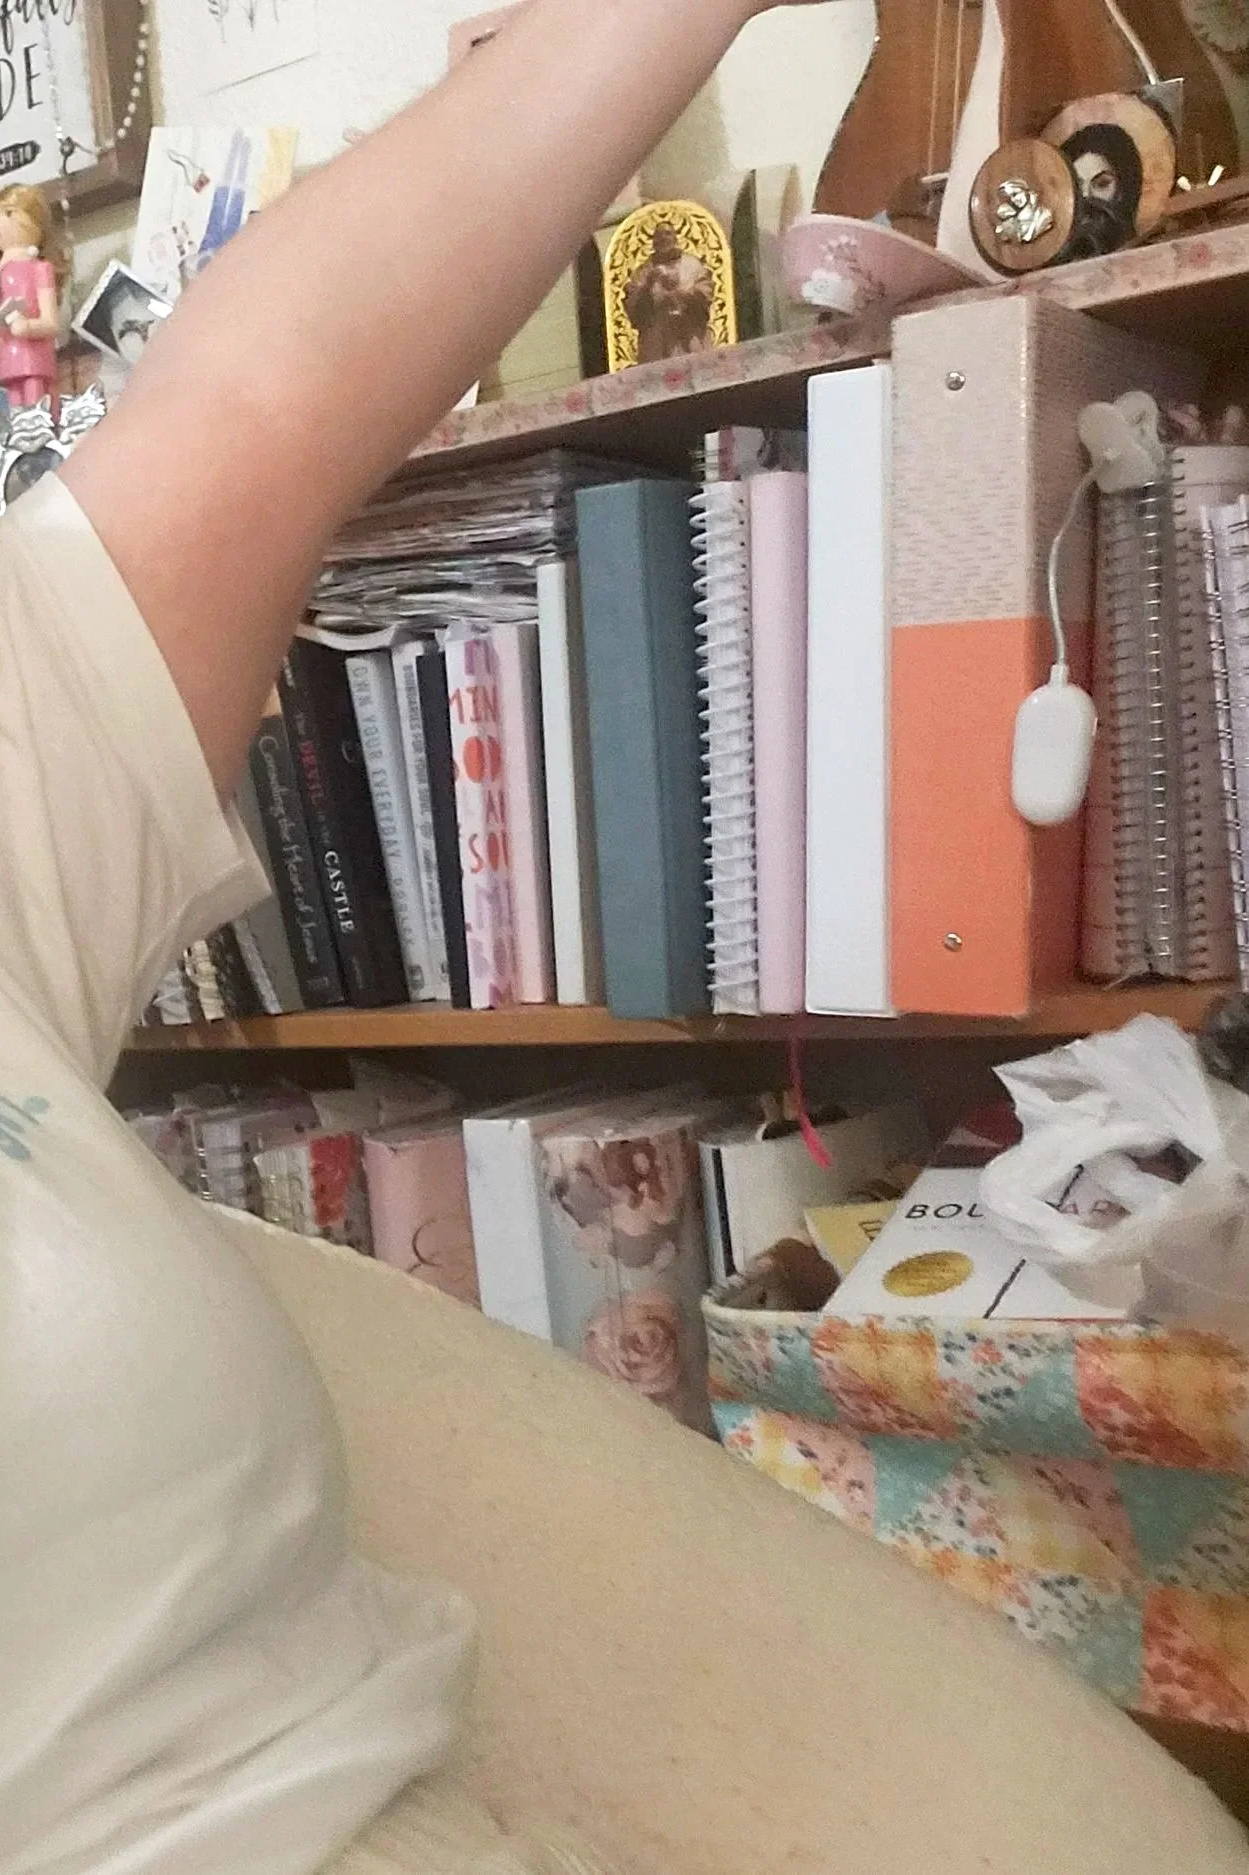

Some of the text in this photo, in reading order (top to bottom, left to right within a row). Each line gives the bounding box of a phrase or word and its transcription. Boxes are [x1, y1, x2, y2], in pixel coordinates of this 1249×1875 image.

[351, 665, 374, 707] OWN
[360, 713, 384, 761] YOUR
[411, 732, 426, 753] FOR
[414, 756, 429, 785] YOUR
[371, 767, 402, 858] EVERYDAY
[323, 850, 355, 934] CASTLE
